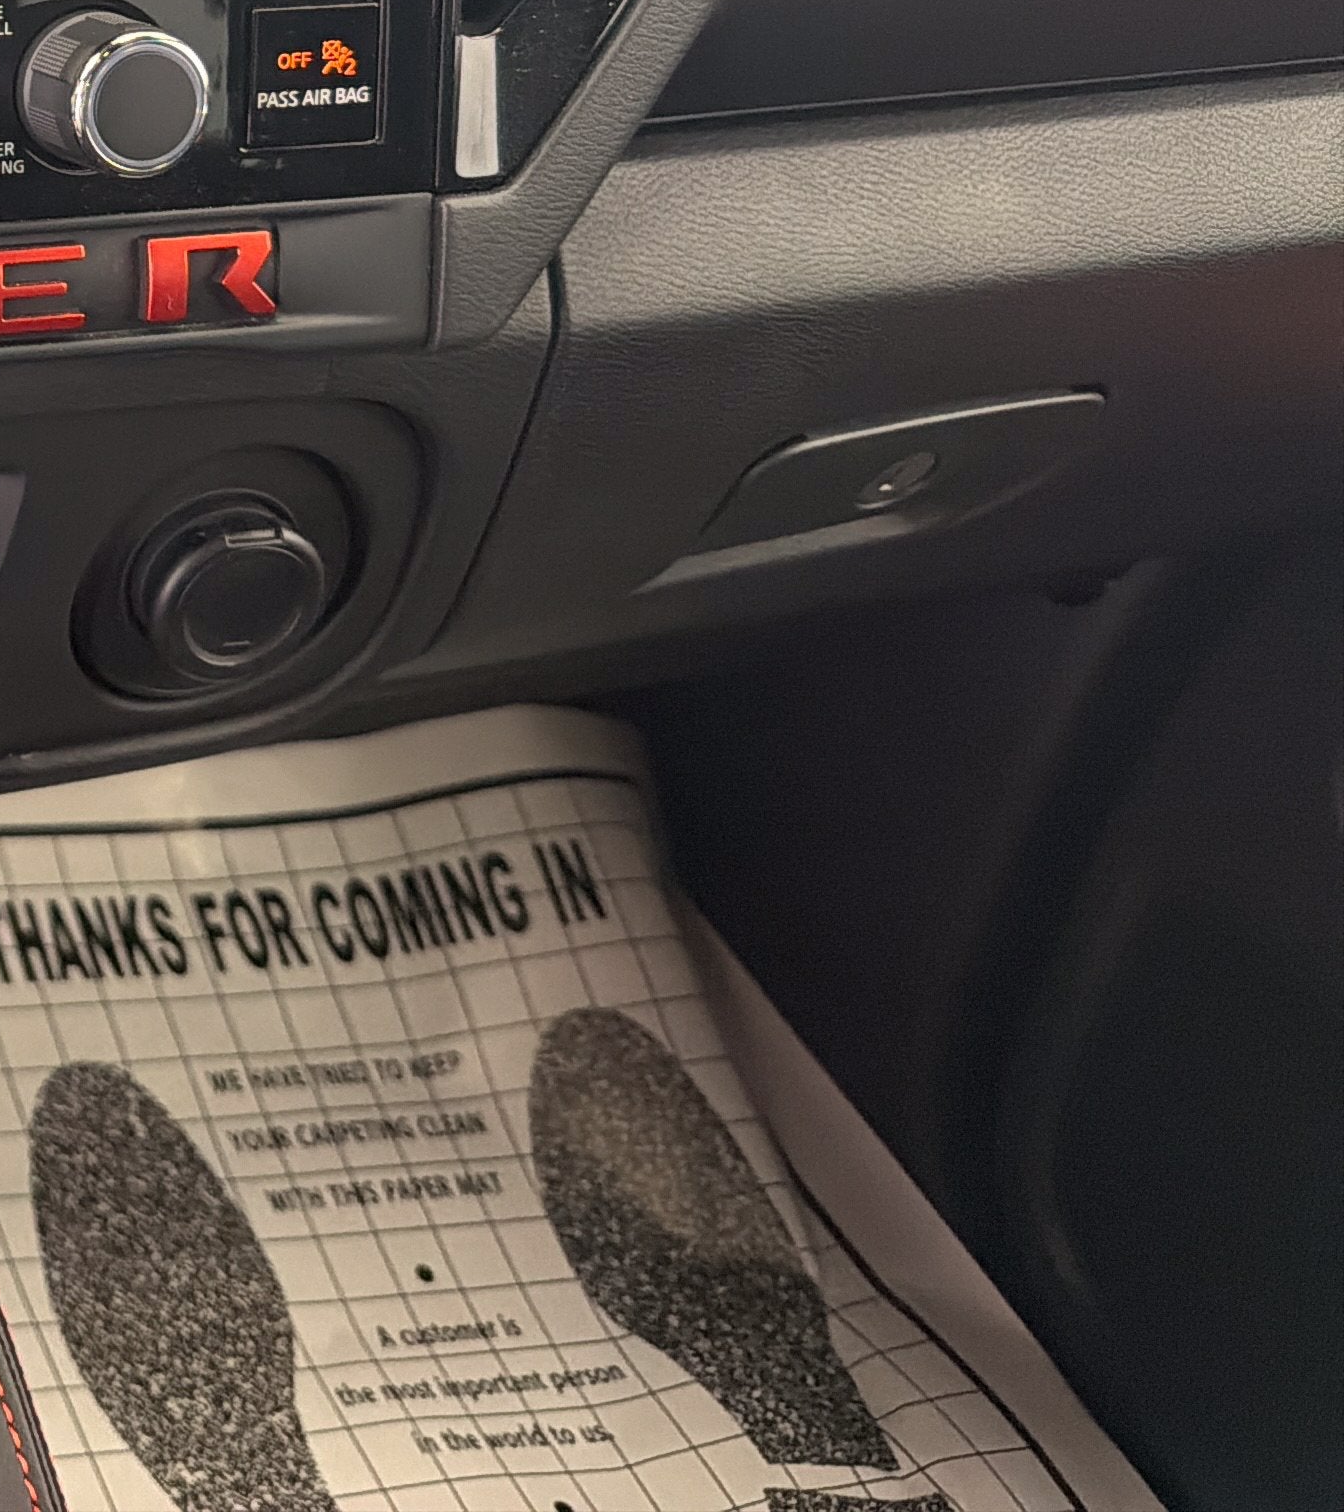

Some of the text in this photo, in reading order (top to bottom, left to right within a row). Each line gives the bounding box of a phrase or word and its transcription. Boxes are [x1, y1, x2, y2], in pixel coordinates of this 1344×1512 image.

[277, 51, 313, 70] OFF
[257, 86, 369, 110] PASS AIR BAG
[191, 888, 309, 974] FOR
[313, 852, 529, 964] COMING
[533, 838, 606, 927] IN
[370, 1057, 404, 1081] TO
[226, 1127, 292, 1152] YOUR
[415, 1110, 487, 1137] CLEAN
[380, 1174, 455, 1202] PAPER
[455, 1170, 502, 1196] MAT
[376, 1313, 522, 1349] A customer is
[334, 1362, 627, 1407] the most important person
[411, 1429, 442, 1454] in
[440, 1425, 483, 1452] the
[483, 1421, 550, 1449] world
[548, 1423, 577, 1445] to
